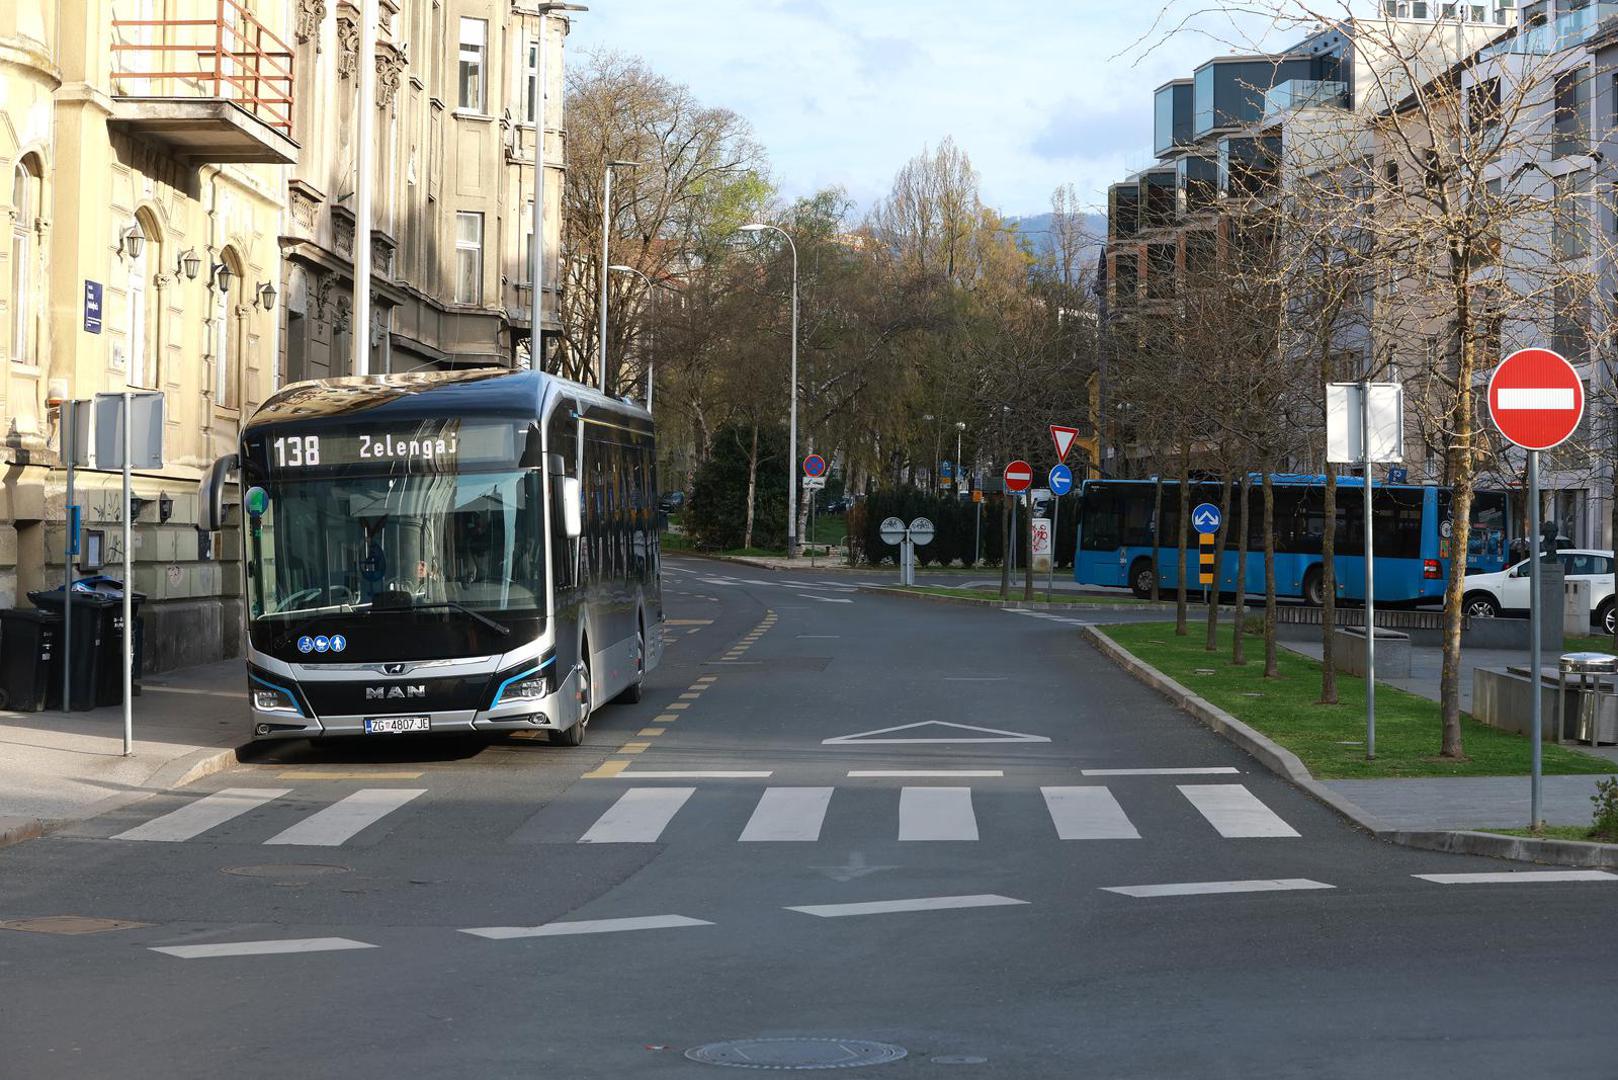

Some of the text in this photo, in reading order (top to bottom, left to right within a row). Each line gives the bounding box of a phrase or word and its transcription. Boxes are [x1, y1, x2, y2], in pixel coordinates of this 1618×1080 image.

[274, 433, 457, 467] 138 Zelengaj
[366, 685, 425, 699] MAN
[372, 720, 384, 732] ZG
